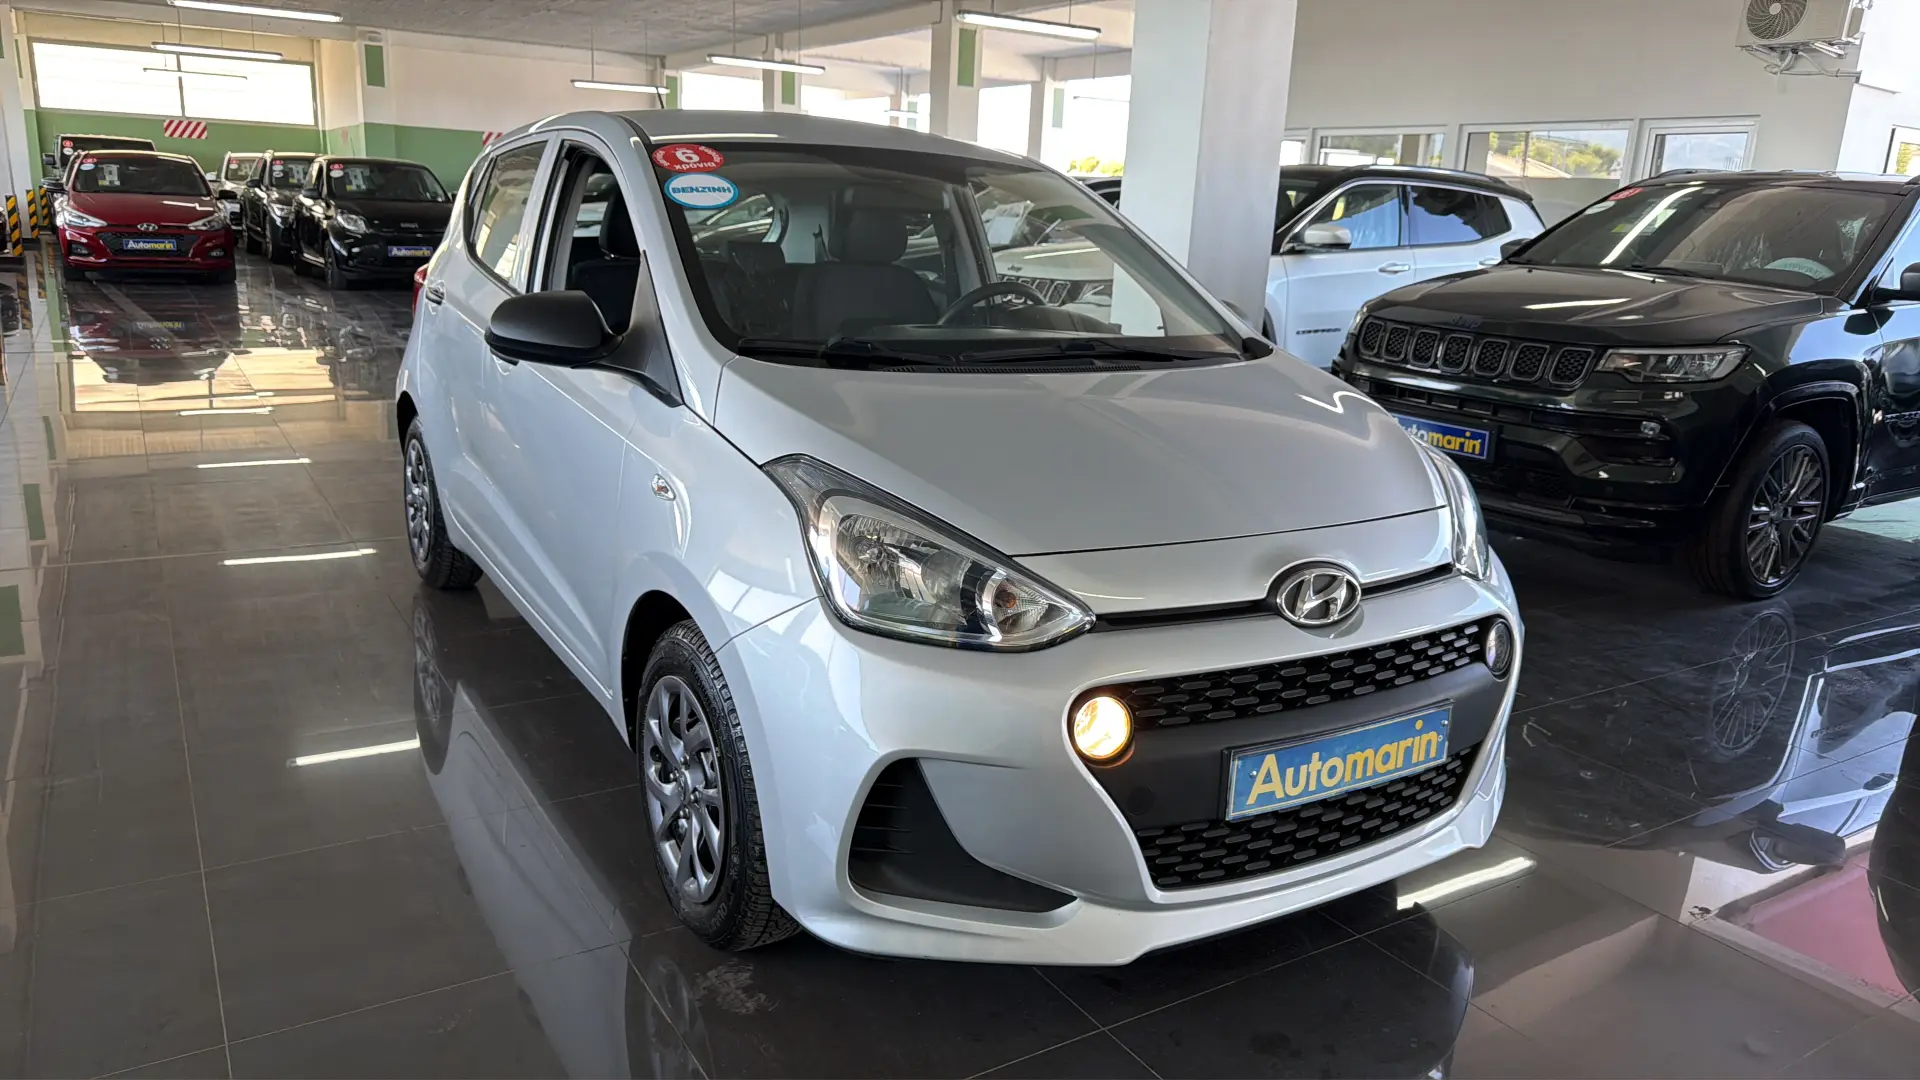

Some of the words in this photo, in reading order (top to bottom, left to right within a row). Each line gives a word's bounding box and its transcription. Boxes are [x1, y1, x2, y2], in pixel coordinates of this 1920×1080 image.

[675, 149, 700, 163] 6
[674, 162, 716, 171] χρόνια
[127, 240, 173, 249] Automarin
[1394, 417, 1481, 455] tomarin
[1246, 719, 1438, 806] Automarin
